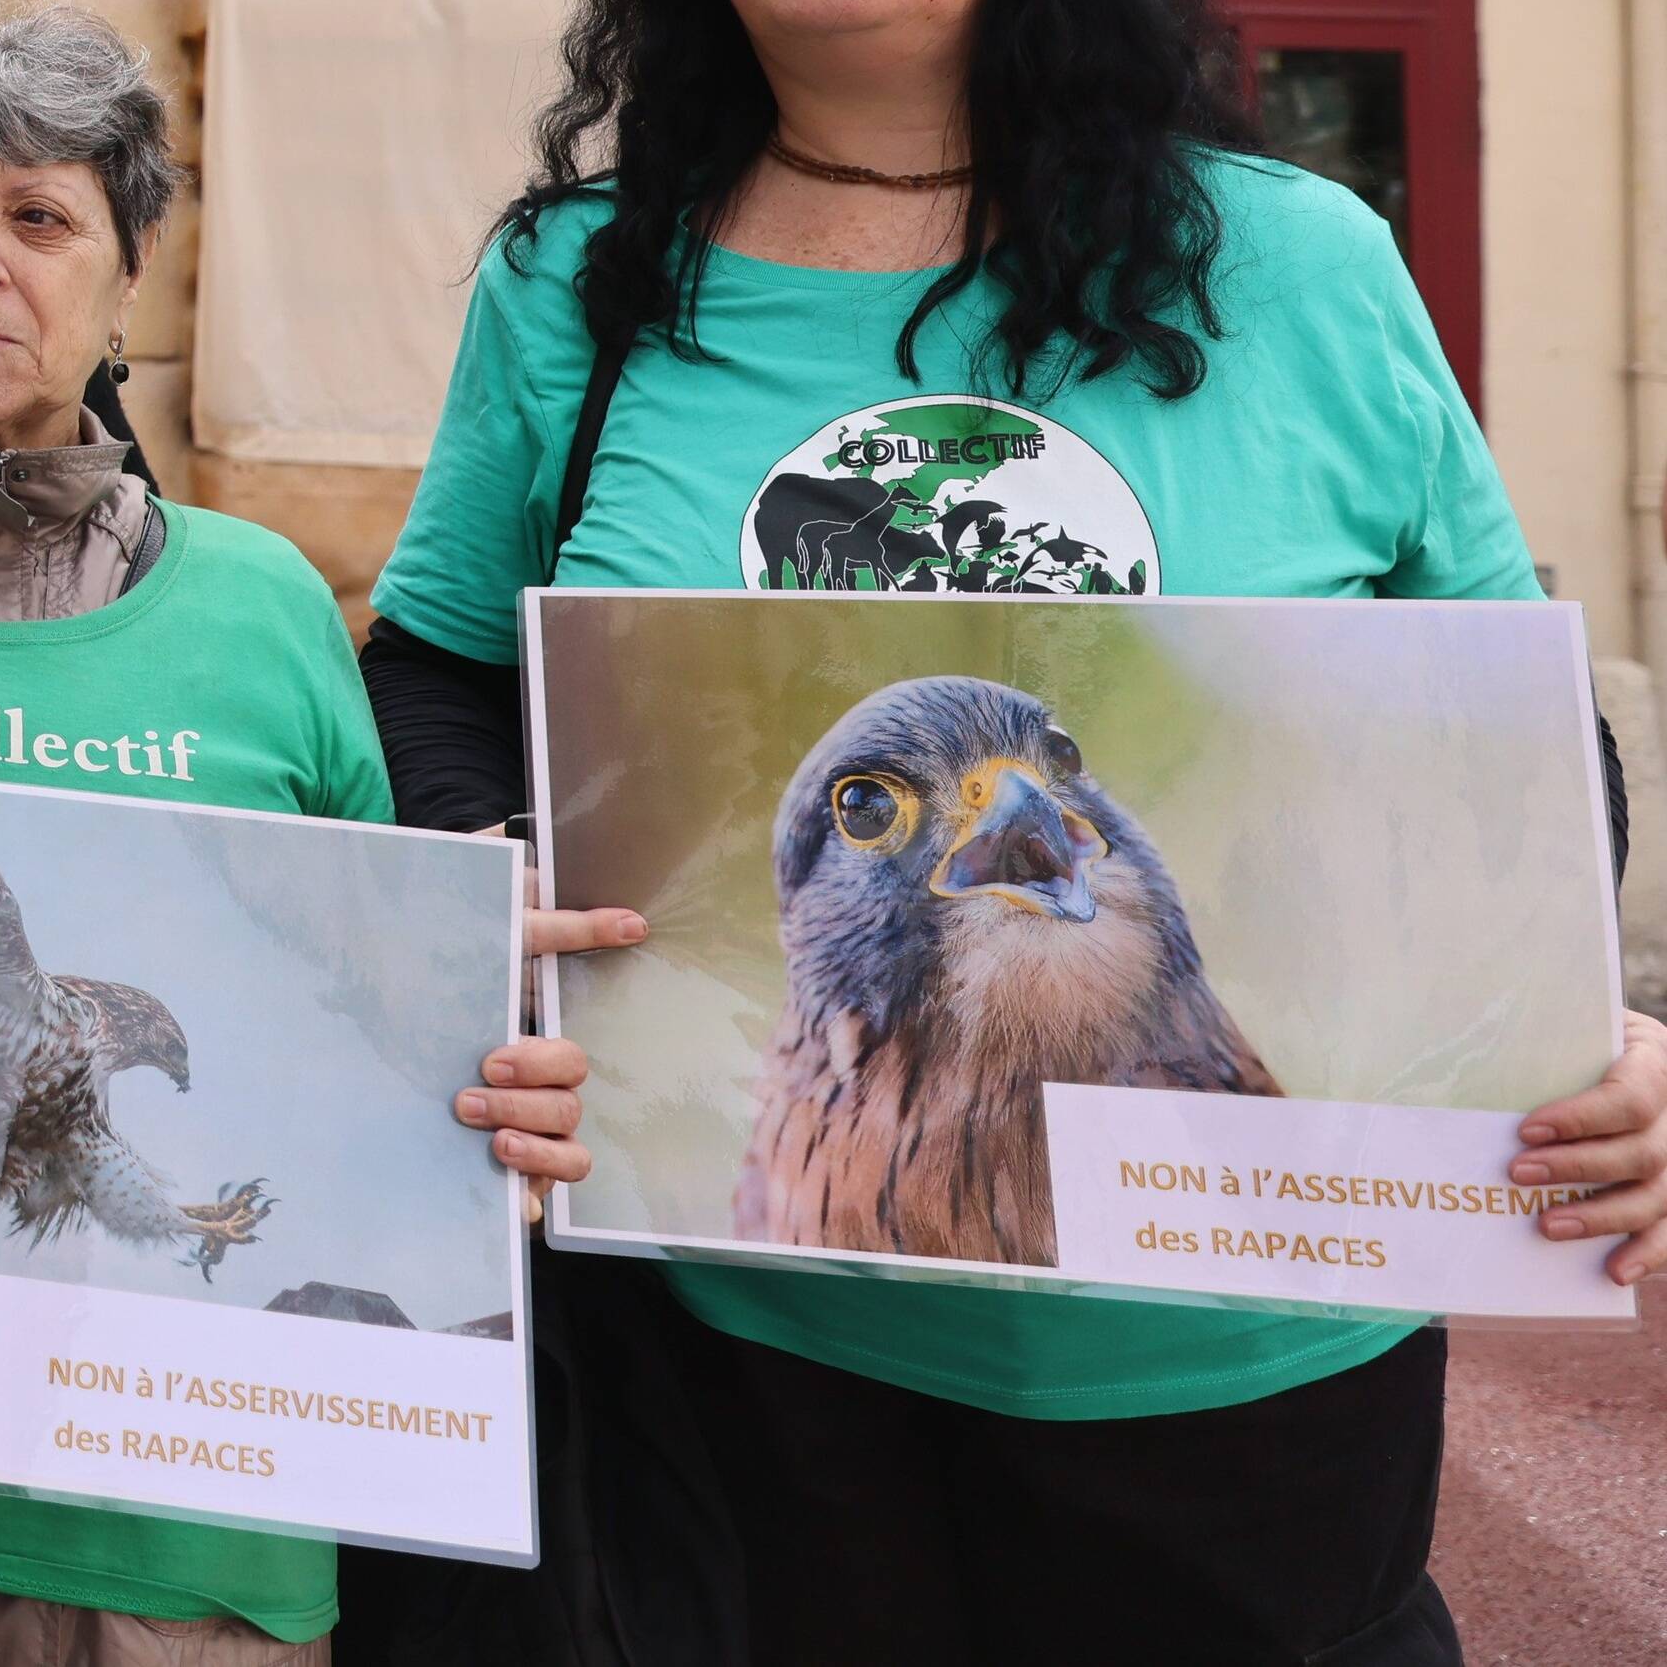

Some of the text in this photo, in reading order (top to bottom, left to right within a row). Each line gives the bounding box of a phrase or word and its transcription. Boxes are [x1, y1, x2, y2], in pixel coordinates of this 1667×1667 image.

[837, 433, 1045, 468] COLLECTIF
[1120, 1161, 1206, 1193] NON
[1221, 1166, 1240, 1196] à
[1136, 1221, 1386, 1267] des RAPACES
[49, 1358, 124, 1394] NON
[136, 1368, 153, 1398] à
[54, 1420, 275, 1477] des RAPACES
